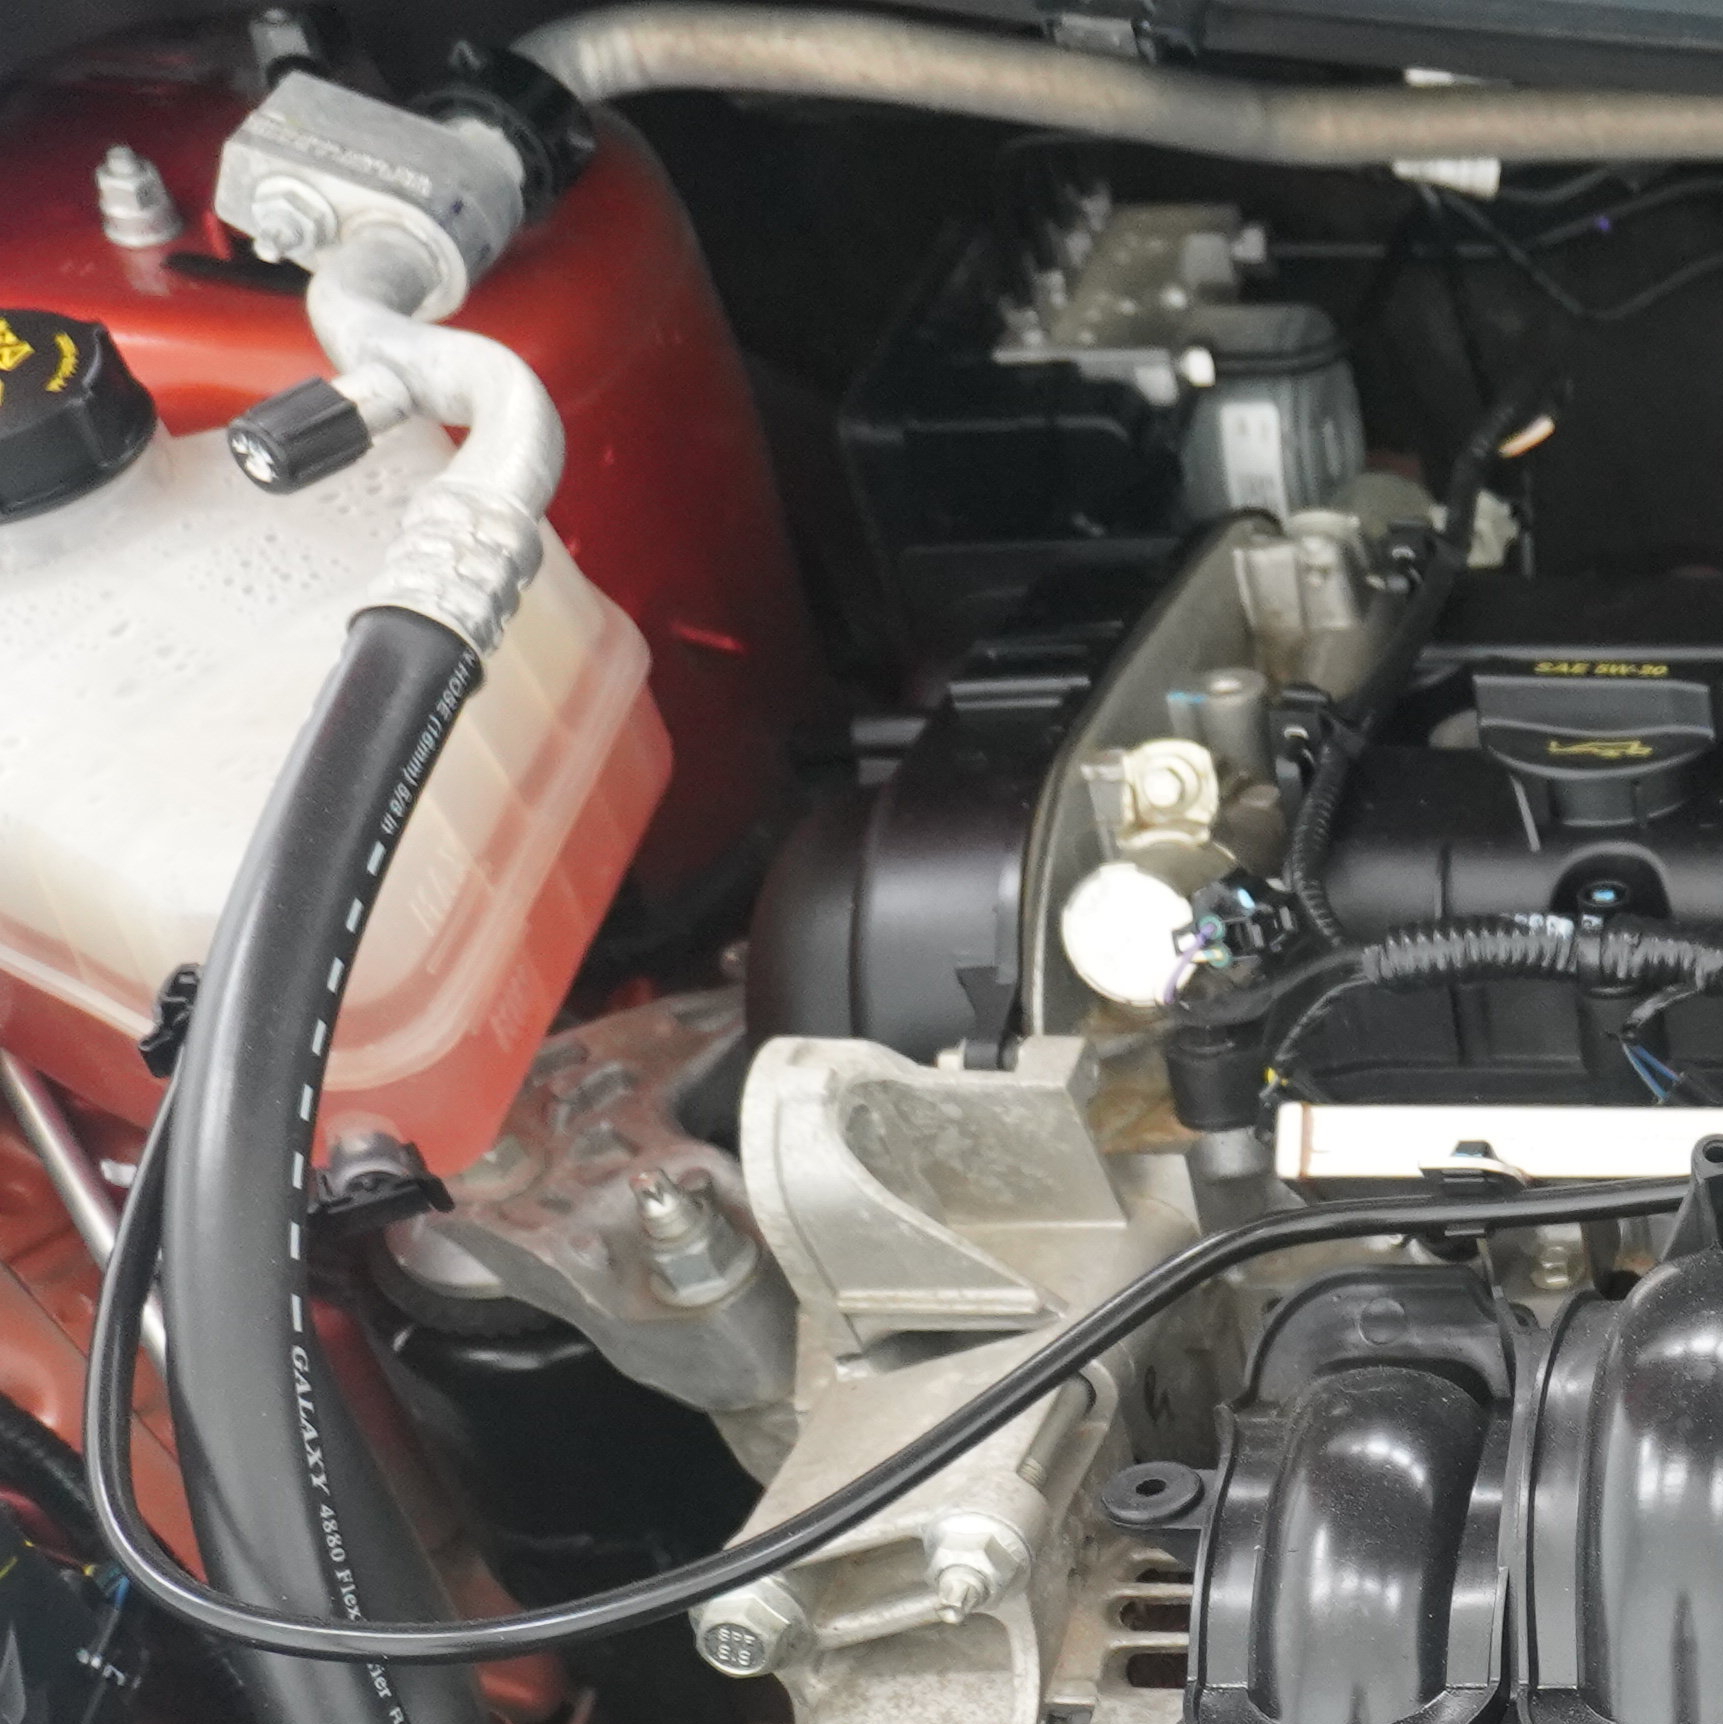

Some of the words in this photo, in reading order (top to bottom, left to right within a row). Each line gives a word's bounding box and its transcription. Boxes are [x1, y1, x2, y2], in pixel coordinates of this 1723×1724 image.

[1534, 661, 1590, 675] SAE
[291, 1344, 331, 1497] GALAXY
[319, 1503, 346, 1563] 4880
